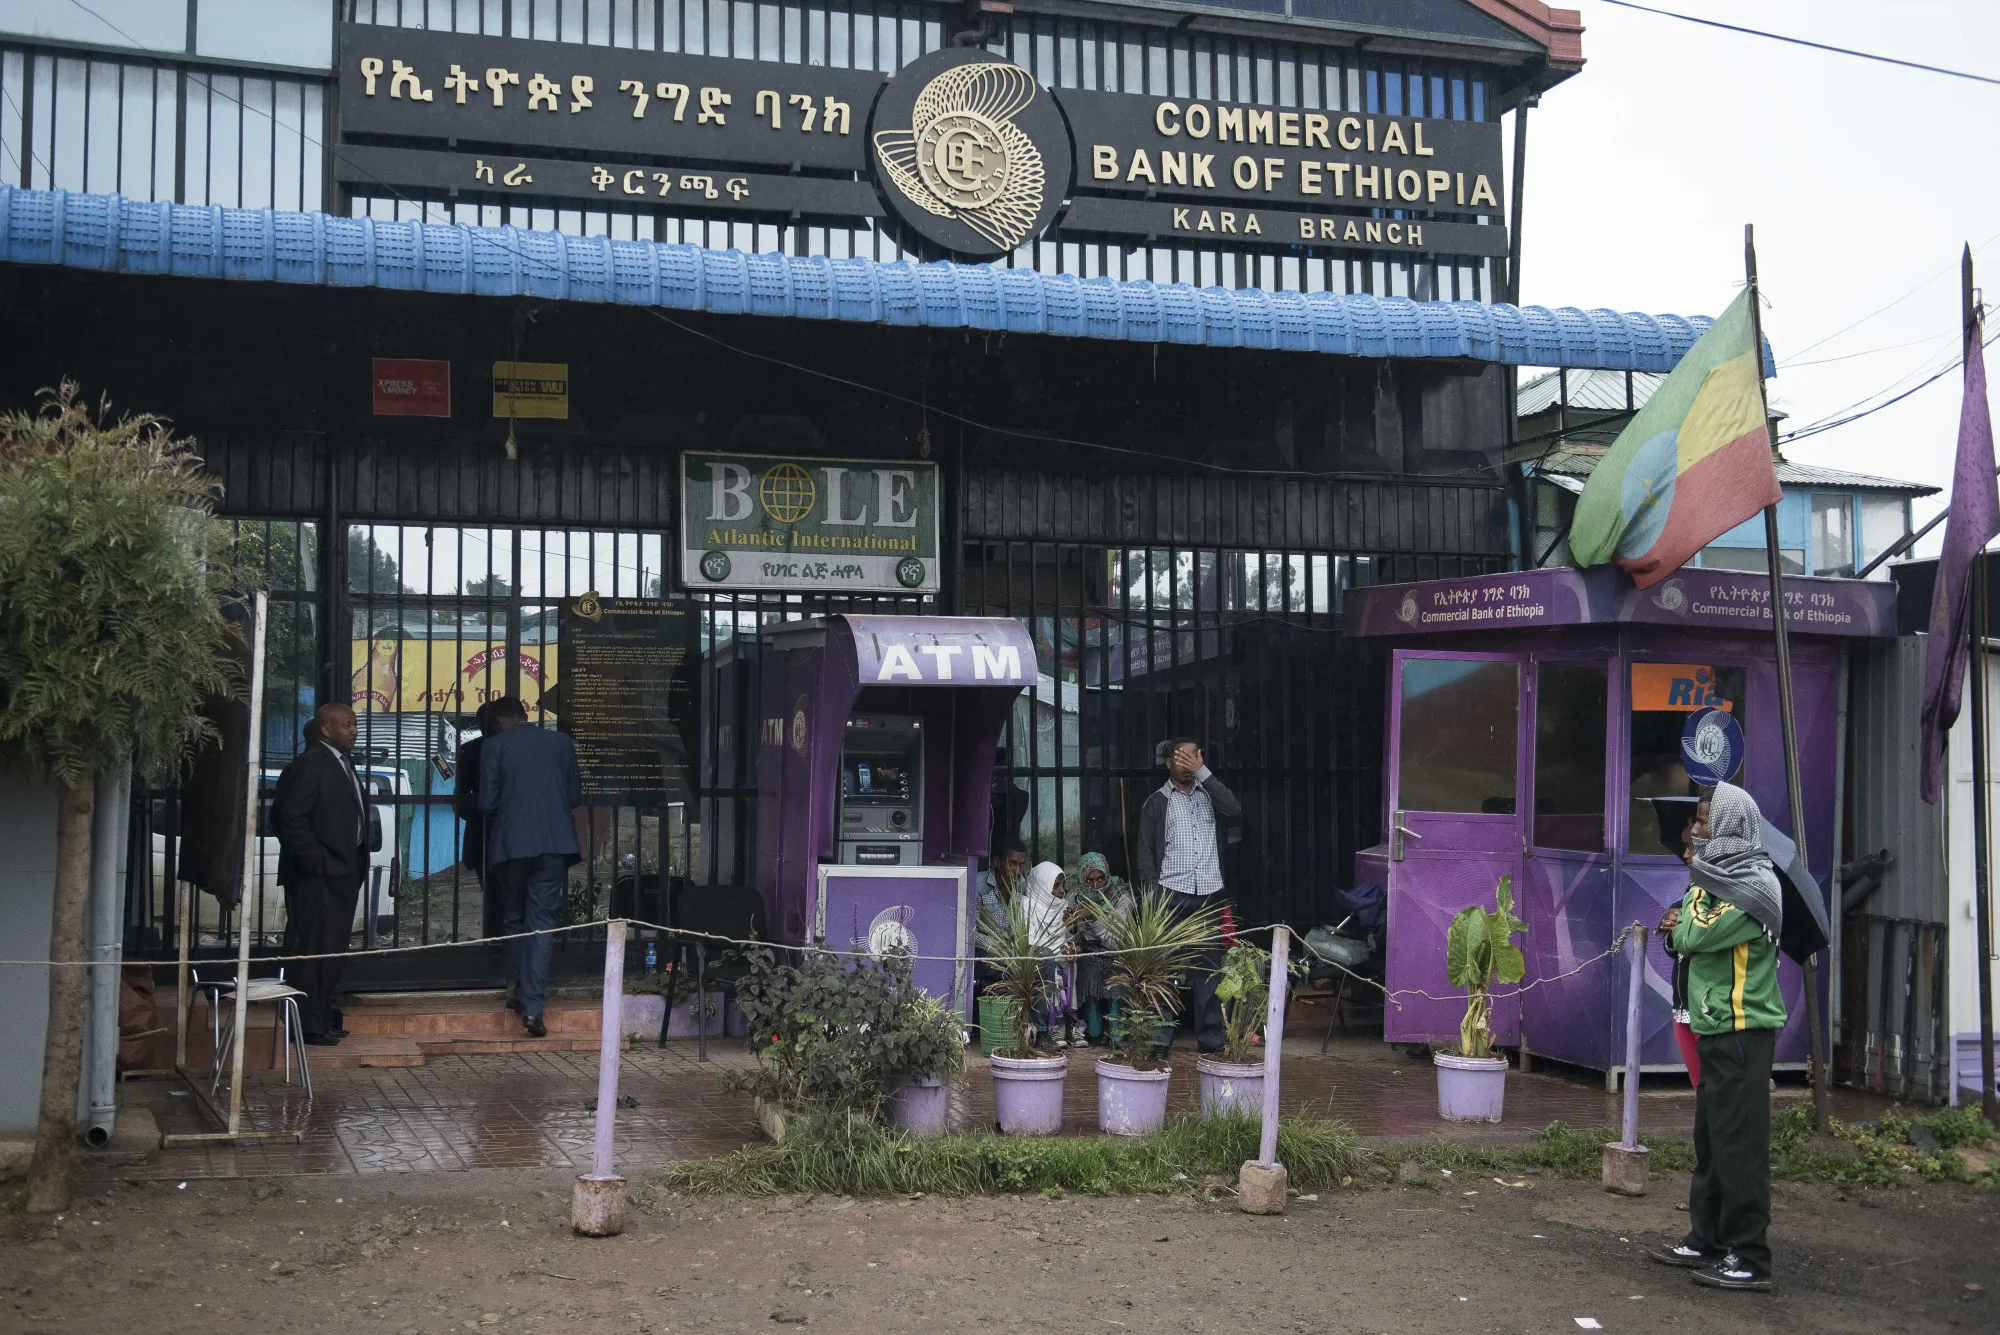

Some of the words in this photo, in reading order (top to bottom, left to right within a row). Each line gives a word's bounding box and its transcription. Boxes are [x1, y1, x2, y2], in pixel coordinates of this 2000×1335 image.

[360, 57, 594, 115] የኢትዮጵያ
[619, 80, 732, 125] ንግድ
[755, 89, 851, 135] ባንክ
[1156, 101, 1434, 157] COMMERCIAL
[476, 159, 533, 186] ካራ
[591, 166, 750, 201] ቅርንጫፍ
[1094, 145, 1215, 189] BANK
[1233, 155, 1285, 192] OF
[1301, 161, 1498, 207] ETHIOPIA
[1173, 208, 1263, 235] KARA
[1300, 218, 1423, 246] BRANCH
[707, 528, 785, 546] Atlantic
[793, 531, 917, 550] International
[1434, 588, 1478, 606] የኢትዮጵያ
[1483, 586, 1504, 602] ንግድ
[1509, 584, 1530, 600] ባንክ
[1710, 585, 1770, 603] የኢትዮጵያ
[1810, 593, 1835, 607] ባንክ
[1421, 608, 1469, 623] Commercial
[1472, 606, 1493, 620] Bank
[1496, 605, 1504, 618] of
[1507, 603, 1544, 620] Ethiopia
[1692, 602, 1760, 618] Commercial
[1793, 609, 1805, 621] of
[1807, 610, 1851, 625] Ethiopia
[877, 645, 1022, 680] ATM
[1667, 668, 1724, 706] Ria
[761, 718, 784, 746] ATM
